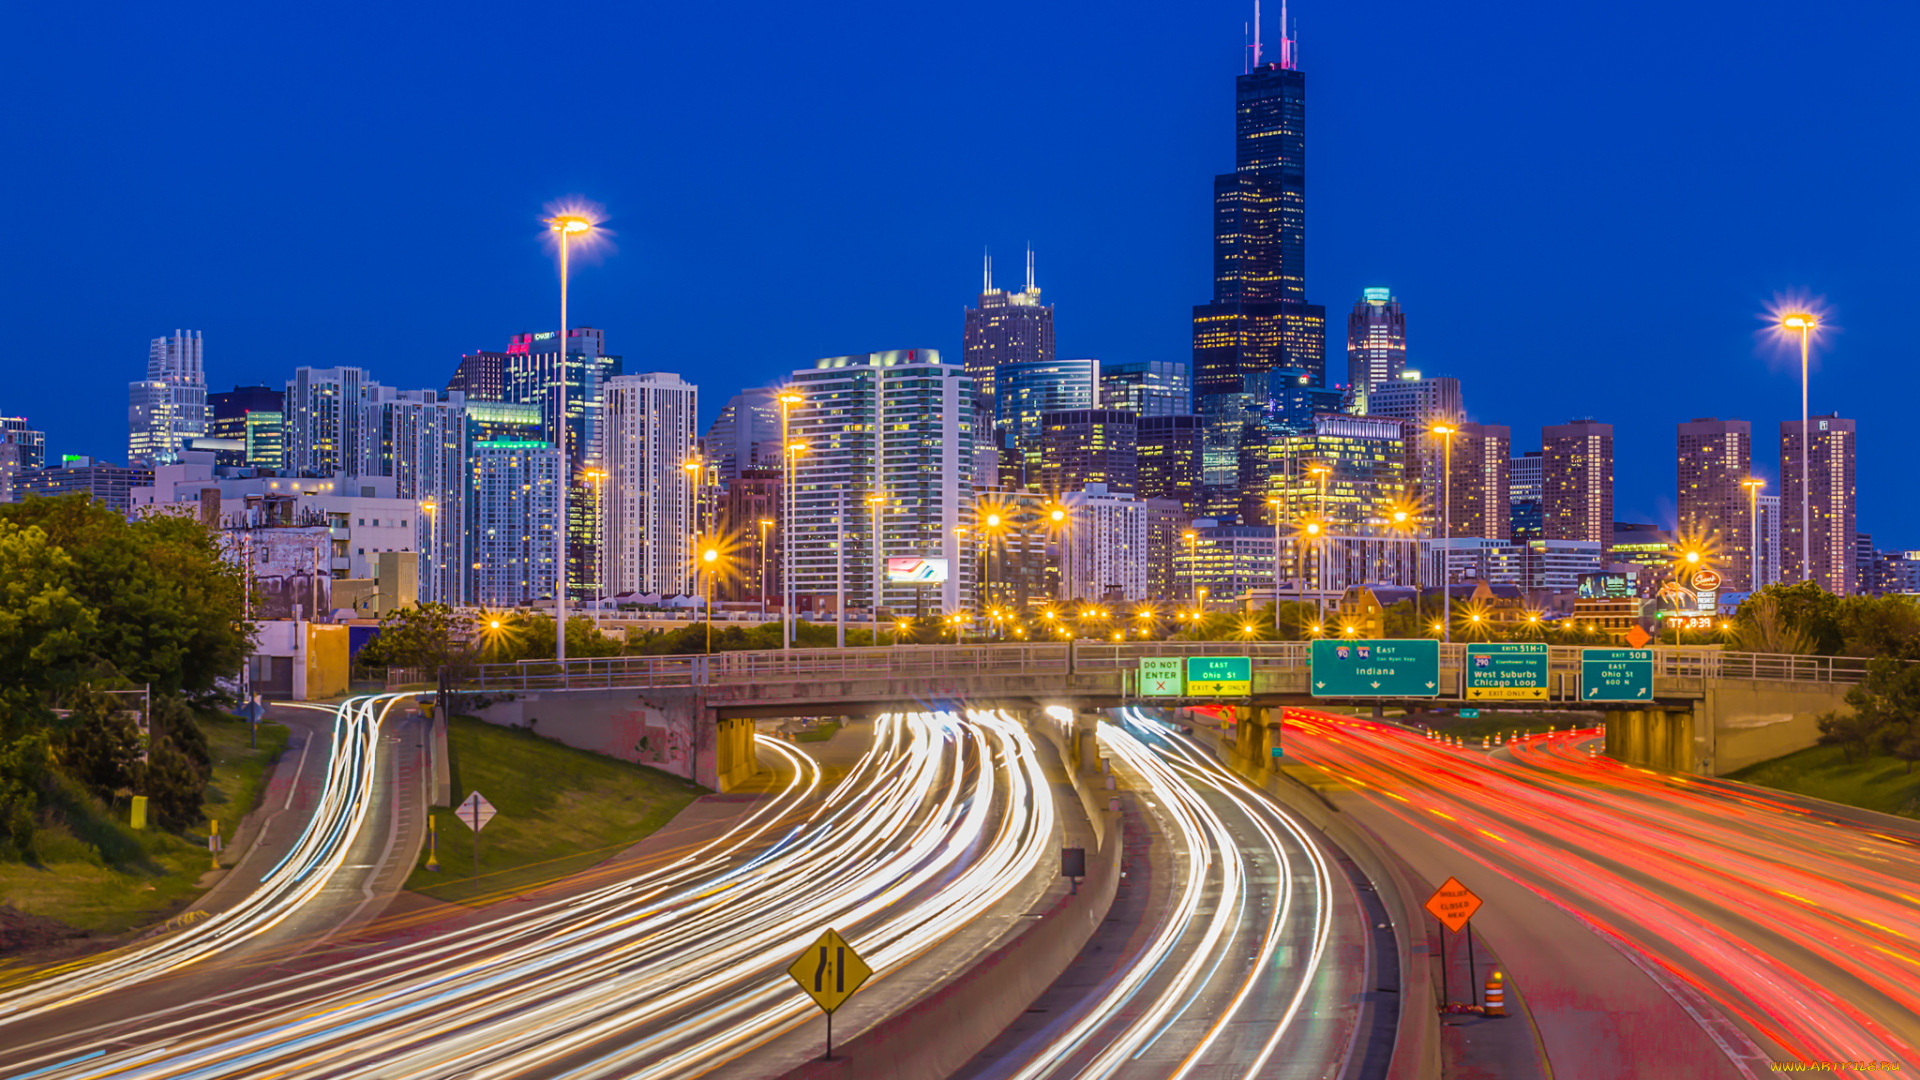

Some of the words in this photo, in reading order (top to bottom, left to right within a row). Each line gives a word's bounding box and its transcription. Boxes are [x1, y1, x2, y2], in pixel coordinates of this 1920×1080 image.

[1690, 617, 1711, 628] 8:39
[1337, 650, 1348, 658] 90
[1358, 650, 1369, 658] 94
[1203, 671, 1221, 679] Ohio
[1356, 667, 1395, 675] Indiana
[1474, 679, 1510, 687] Chicago
[1514, 679, 1537, 687] Loop
[1440, 901, 1469, 910] CLOSED
